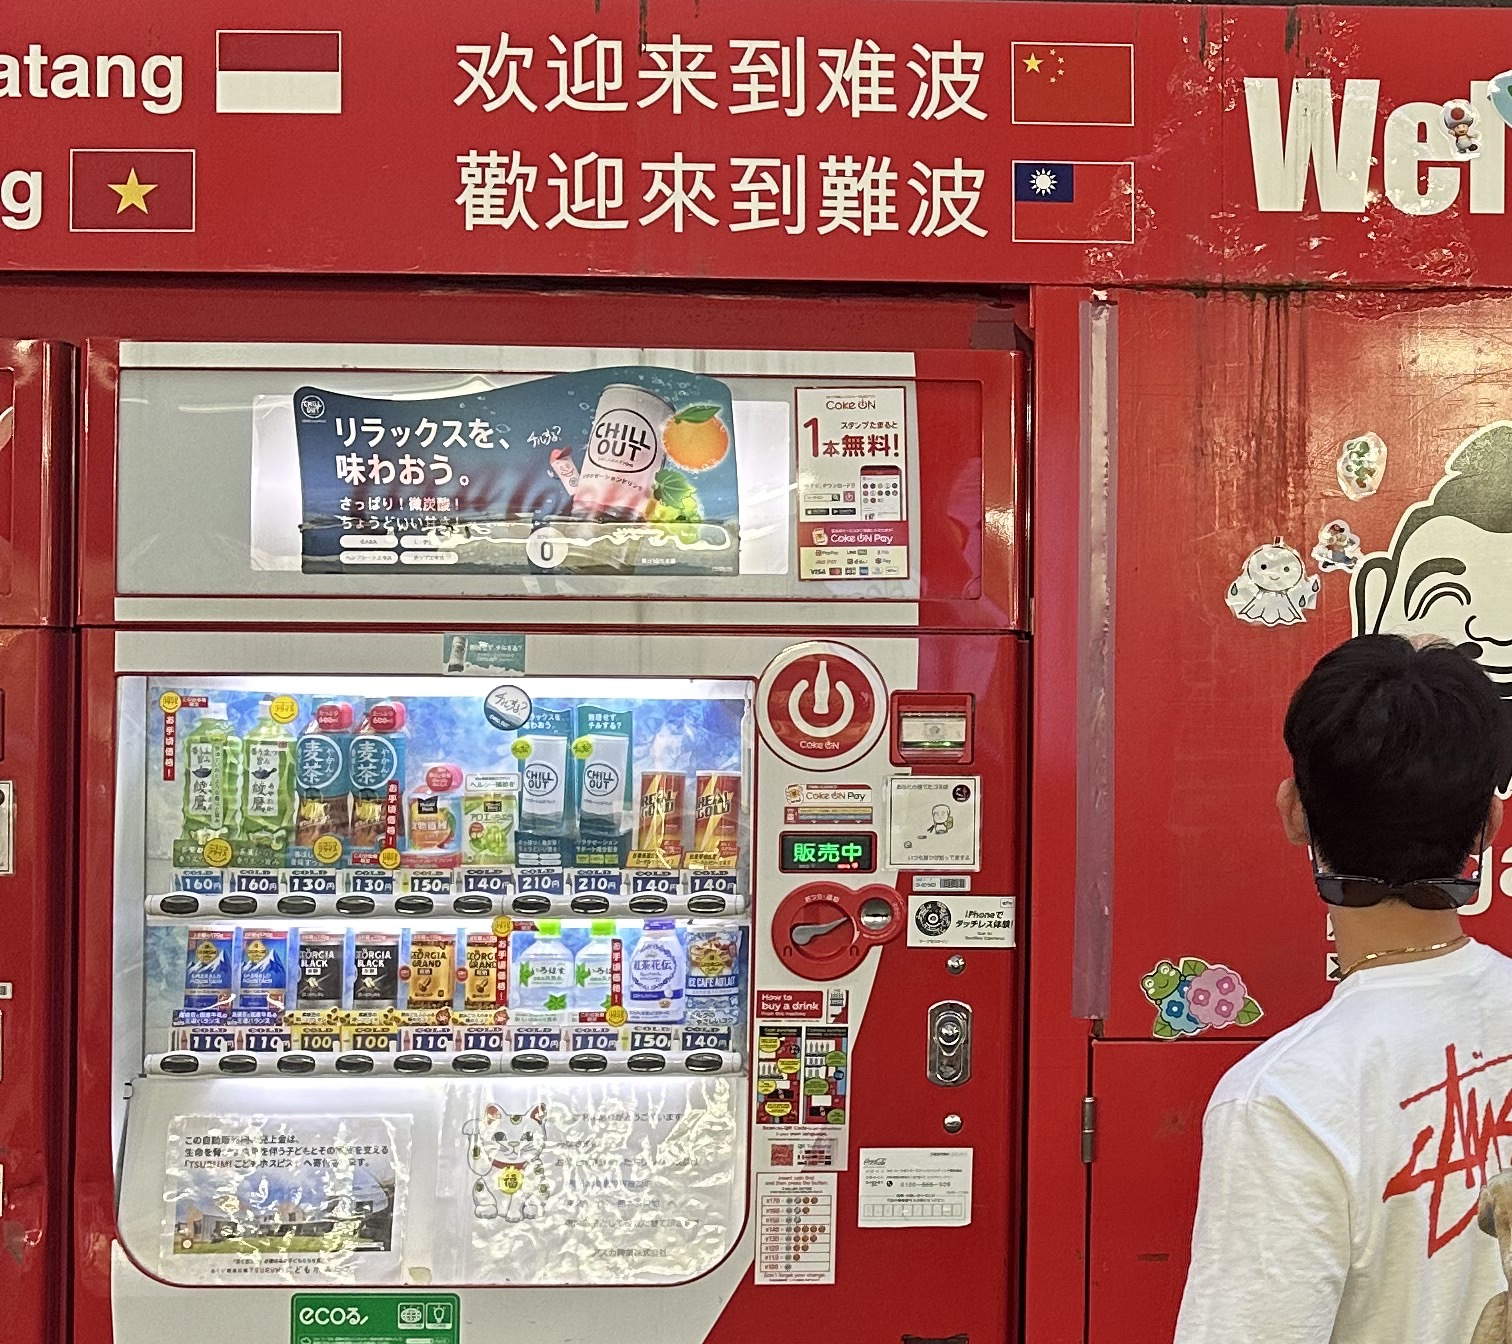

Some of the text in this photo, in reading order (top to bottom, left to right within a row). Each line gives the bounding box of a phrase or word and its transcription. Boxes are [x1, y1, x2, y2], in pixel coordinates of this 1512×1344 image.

[453, 32, 988, 122] 欢迎来到难波
[453, 149, 989, 238] 歡迎來到難波
[334, 417, 511, 449] リラックスを、
[595, 422, 651, 450] CHILL
[803, 417, 900, 458] 1本無料!
[597, 439, 642, 462] OUT
[335, 452, 470, 486] 味わおう。
[302, 739, 325, 784] 麦茶
[356, 740, 380, 785] 麦茶
[525, 770, 553, 781] CHILL
[586, 770, 615, 782] CHILL
[528, 779, 549, 789] OUT
[589, 779, 610, 789] OUT
[697, 790, 729, 806] REAL
[696, 802, 730, 819] GOLD
[793, 842, 862, 863] 販売中
[184, 878, 222, 890] 160円
[240, 877, 278, 891] 160円
[292, 878, 335, 892] 130円
[355, 878, 393, 892] 130円
[413, 878, 450, 892] 150円
[522, 876, 560, 889] 210円
[579, 877, 617, 890] 210円
[694, 878, 736, 891] 140円
[633, 959, 673, 971] 紅茶花伝
[761, 994, 793, 1002] How to
[761, 1001, 820, 1012] buy a drink
[516, 1035, 560, 1049] 110円
[575, 1036, 617, 1049] 110円
[685, 1035, 728, 1048] 140円
[503, 1174, 518, 1189] 福
